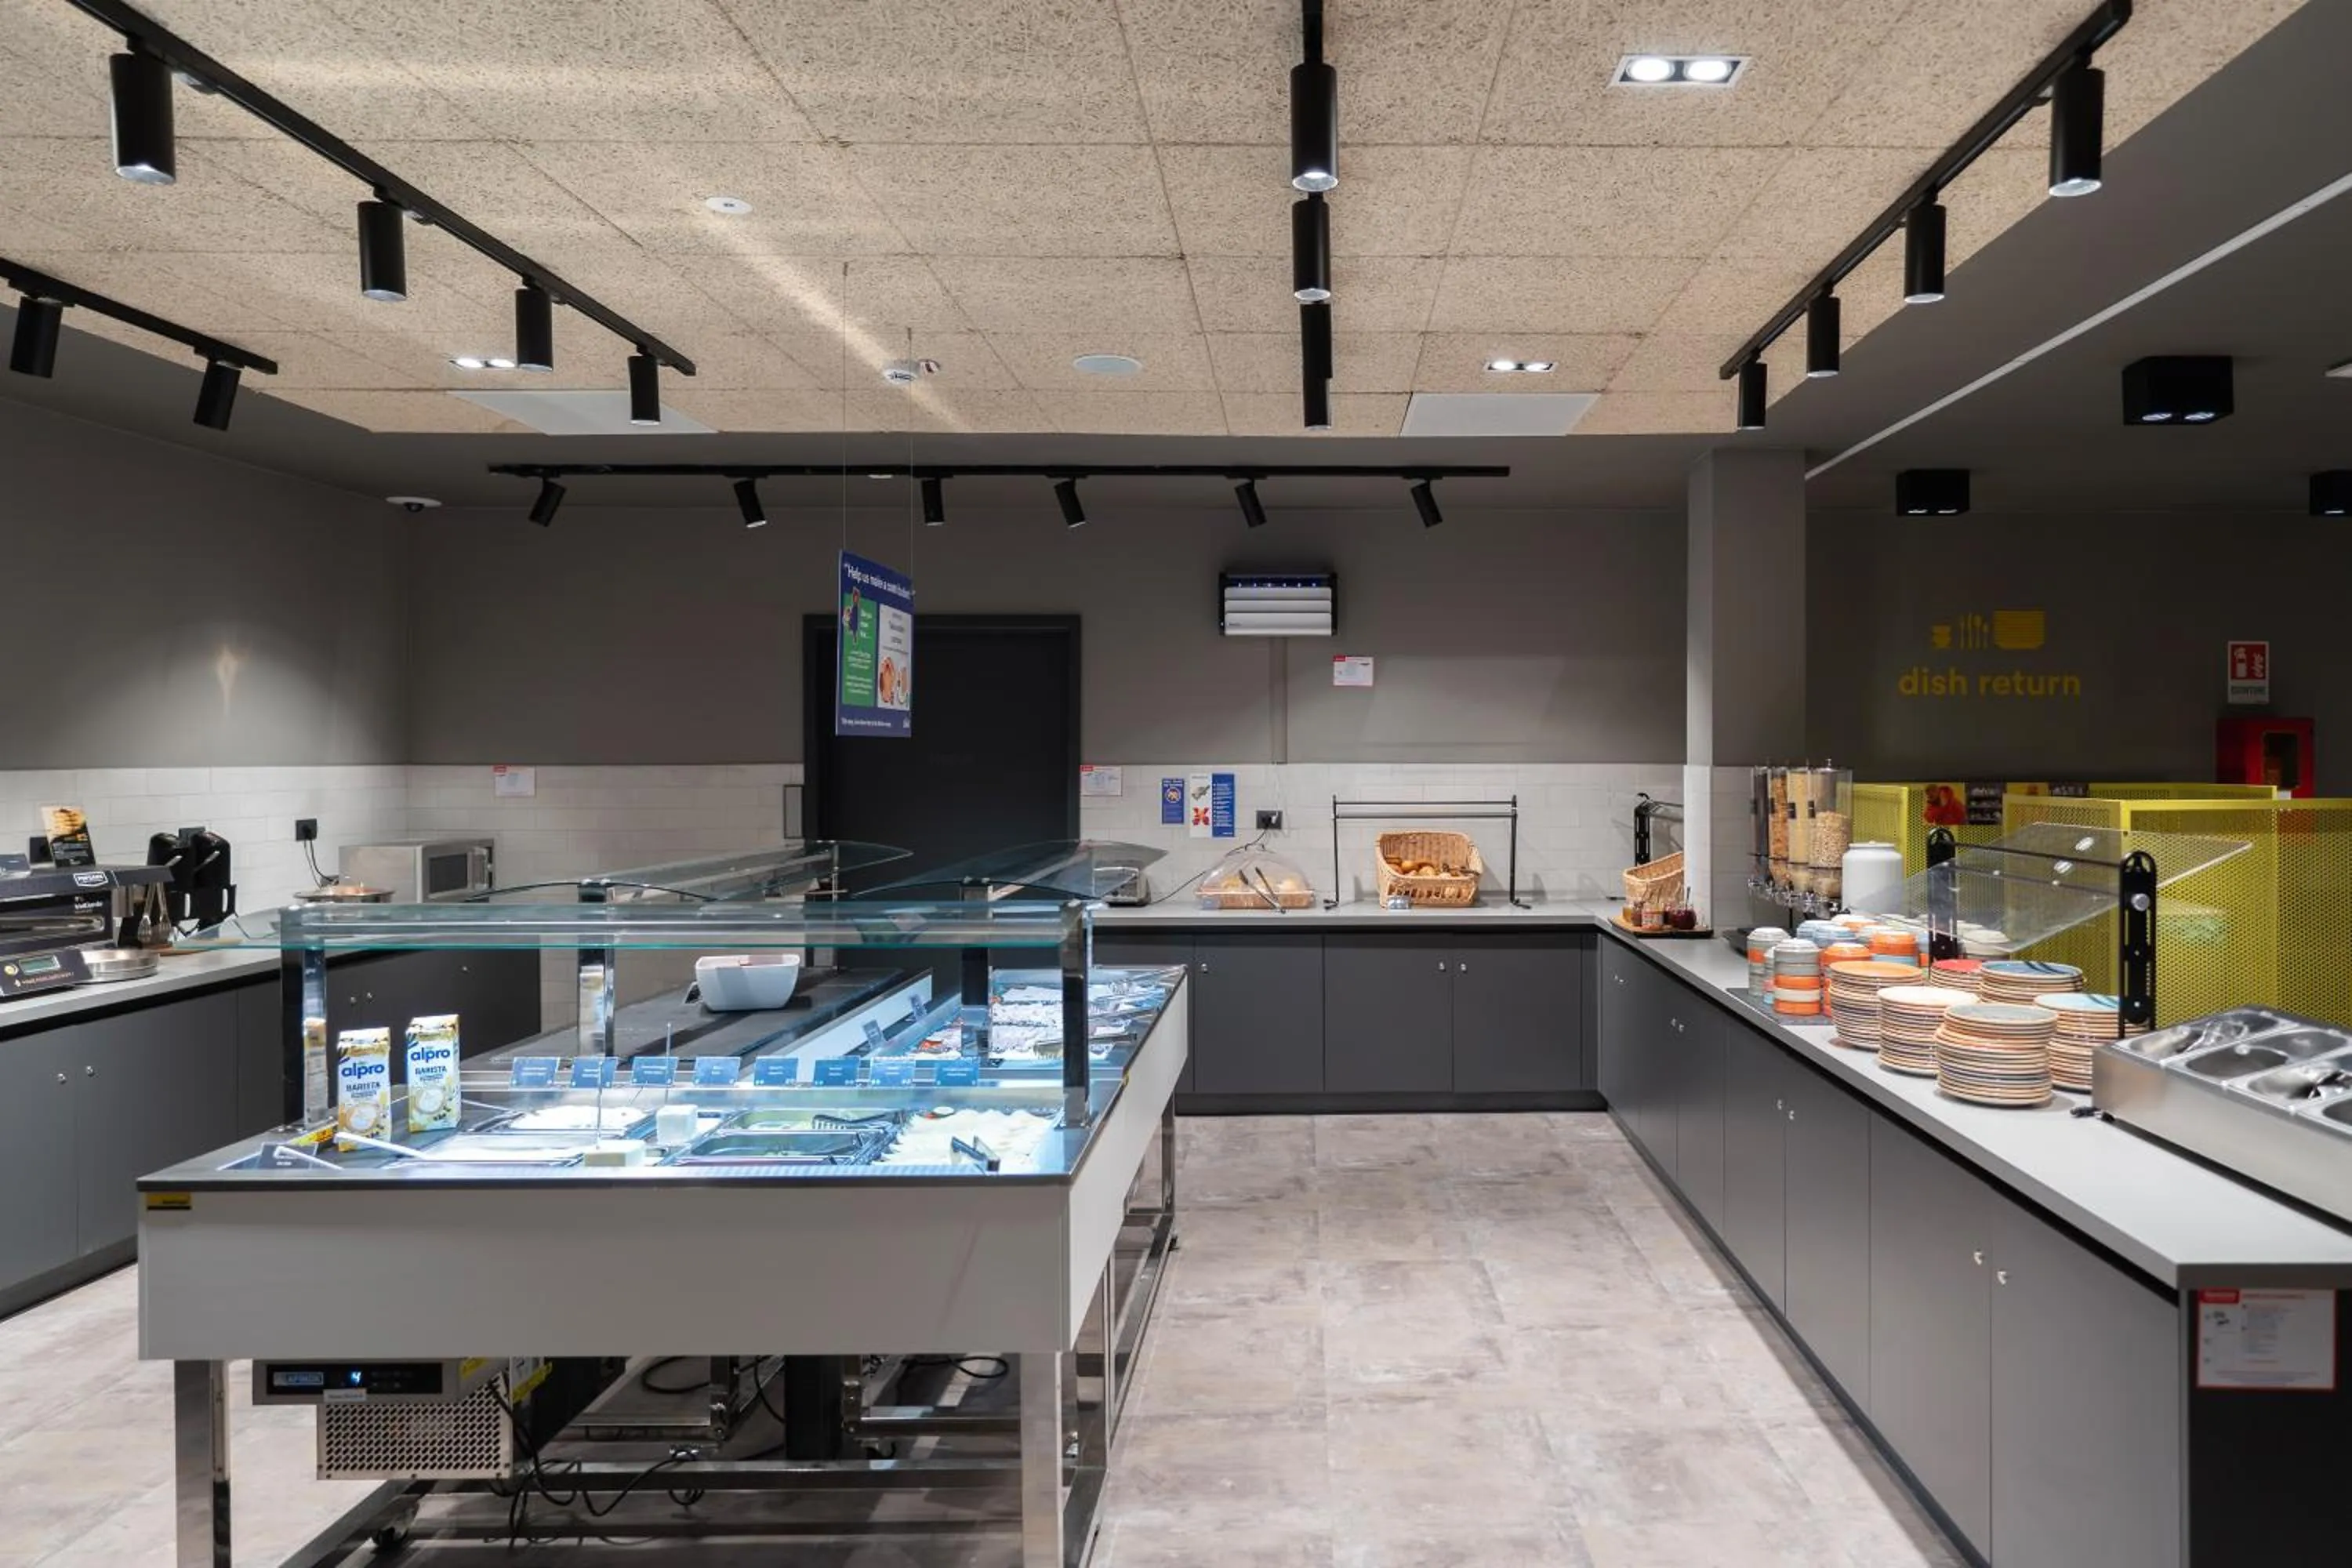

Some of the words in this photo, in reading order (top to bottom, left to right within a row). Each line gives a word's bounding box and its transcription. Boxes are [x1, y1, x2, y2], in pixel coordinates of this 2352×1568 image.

[1899, 666, 1968, 696] dish
[1979, 670, 2080, 696] return
[410, 1047, 451, 1063] alpro
[341, 1061, 385, 1079] alpro
[415, 1065, 448, 1075] BARISTA
[346, 1081, 381, 1091] BARISTA
[352, 1371, 361, 1383] 4
